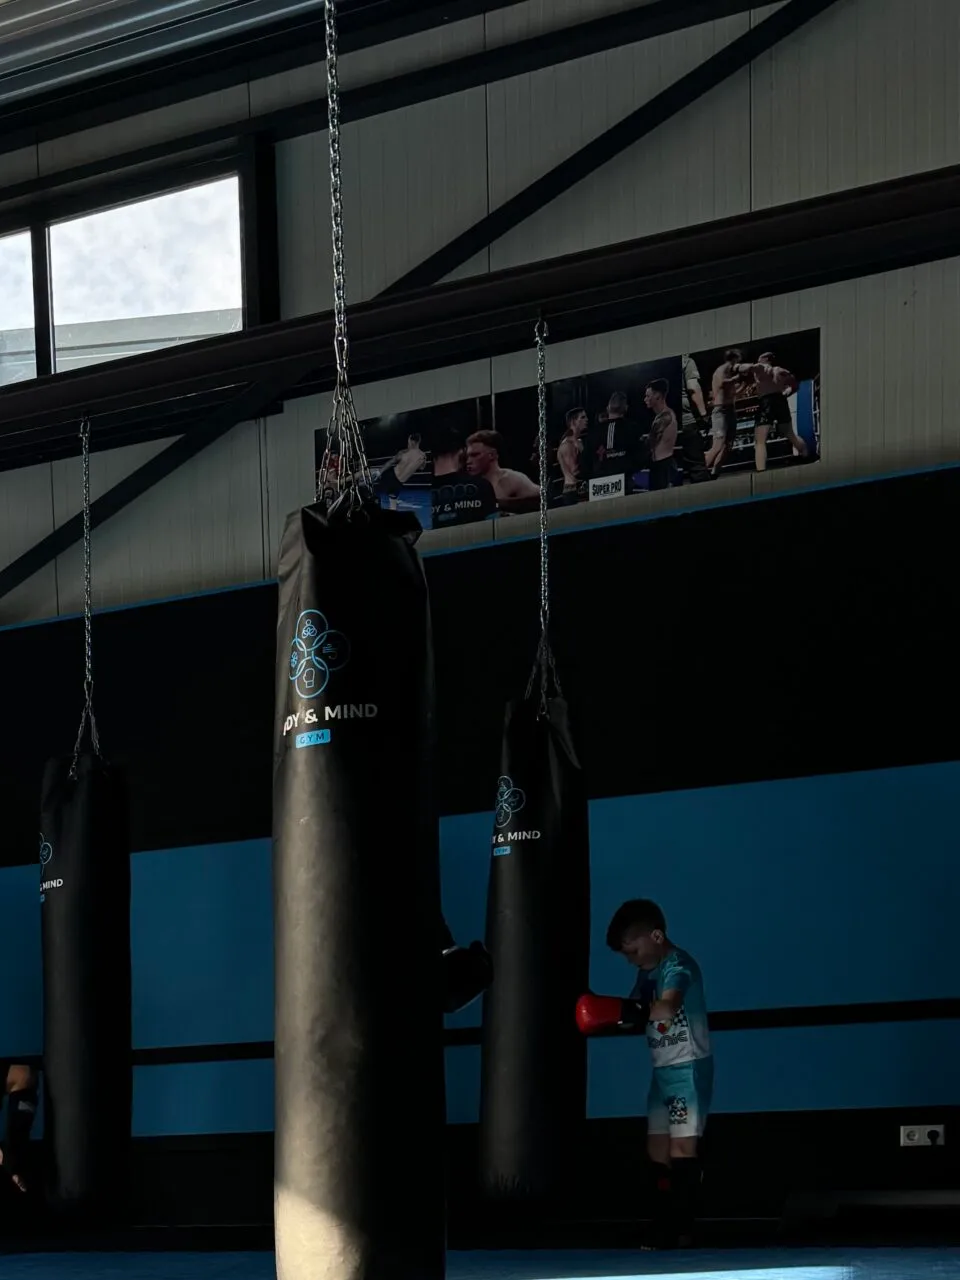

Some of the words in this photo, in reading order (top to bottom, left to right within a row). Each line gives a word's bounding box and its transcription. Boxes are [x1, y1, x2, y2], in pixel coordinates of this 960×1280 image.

[454, 499, 482, 510] MIND
[305, 708, 318, 724] &
[324, 703, 378, 721] MIND
[299, 731, 325, 745] GYM
[497, 833, 505, 844] &
[507, 829, 542, 842] MIND
[42, 878, 64, 890] MIND
